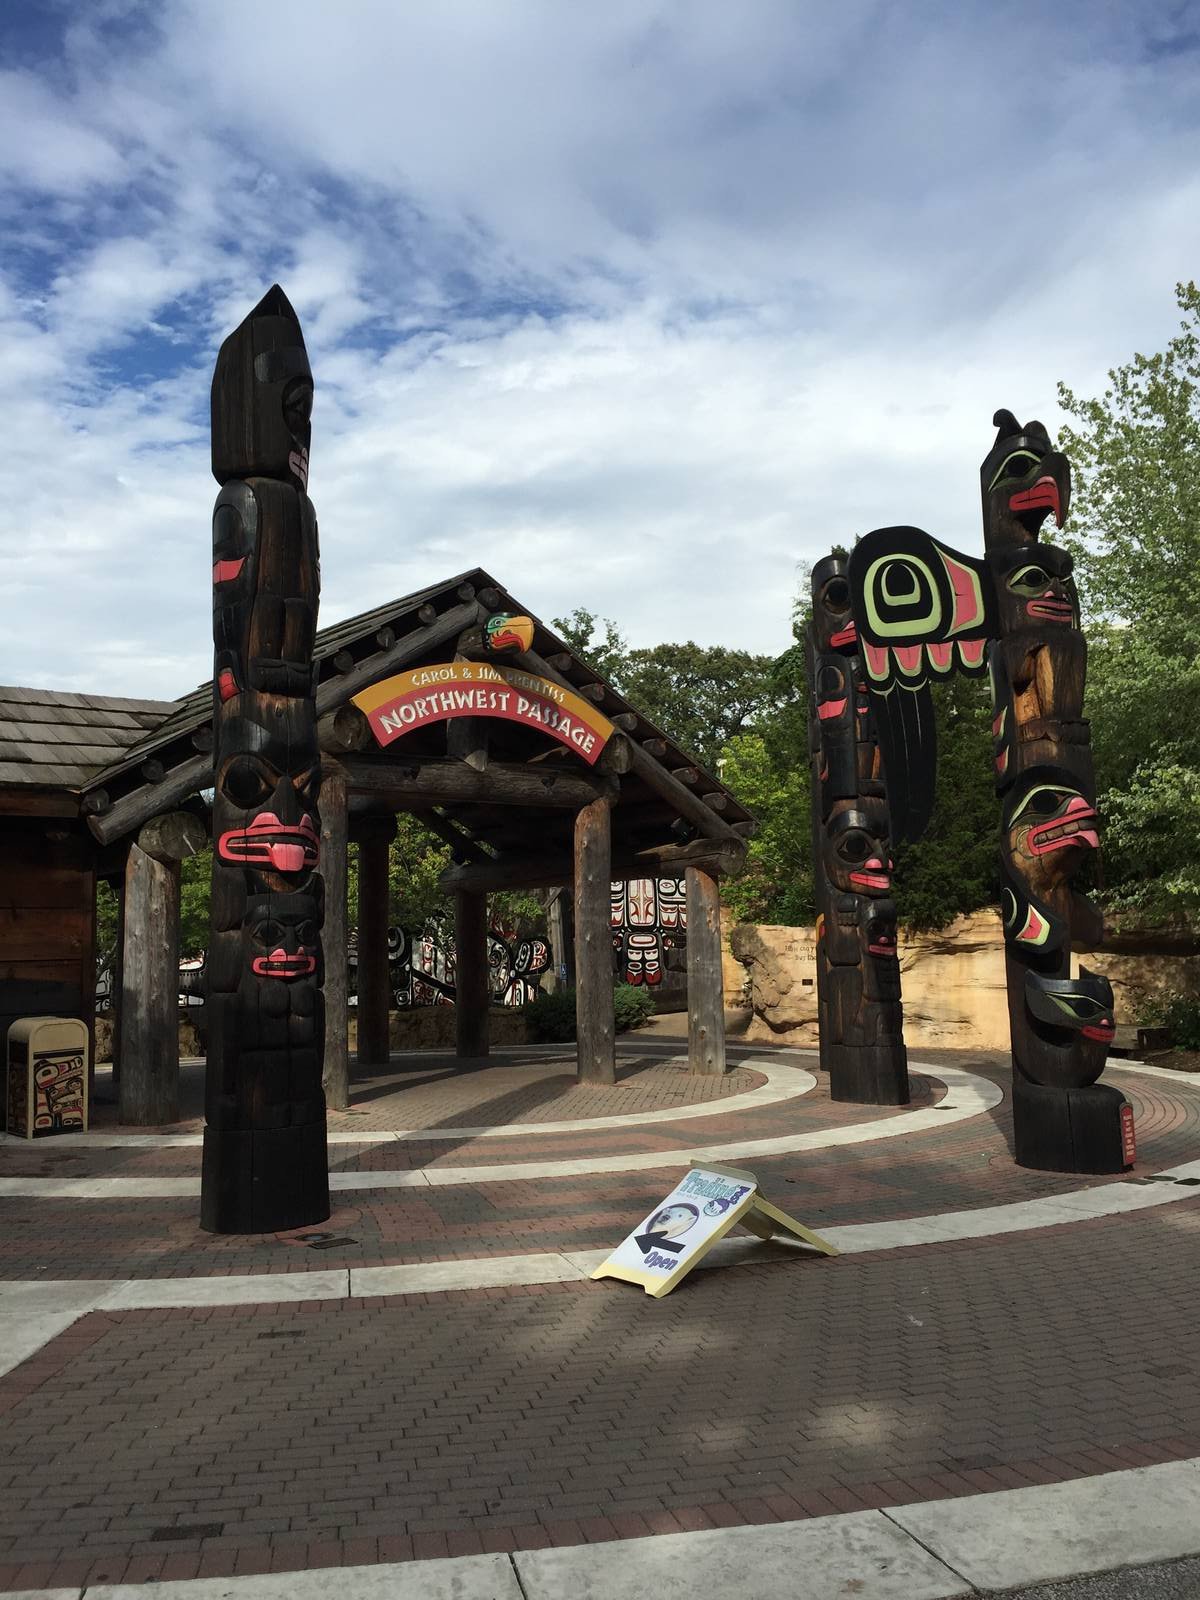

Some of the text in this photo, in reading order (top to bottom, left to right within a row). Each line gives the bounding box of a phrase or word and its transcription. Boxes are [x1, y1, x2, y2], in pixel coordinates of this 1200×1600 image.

[411, 667, 566, 703] CAROL & JIM PRENTISS
[378, 688, 596, 754] NORTHWEST PASSAGE
[643, 1251, 679, 1271] Open
